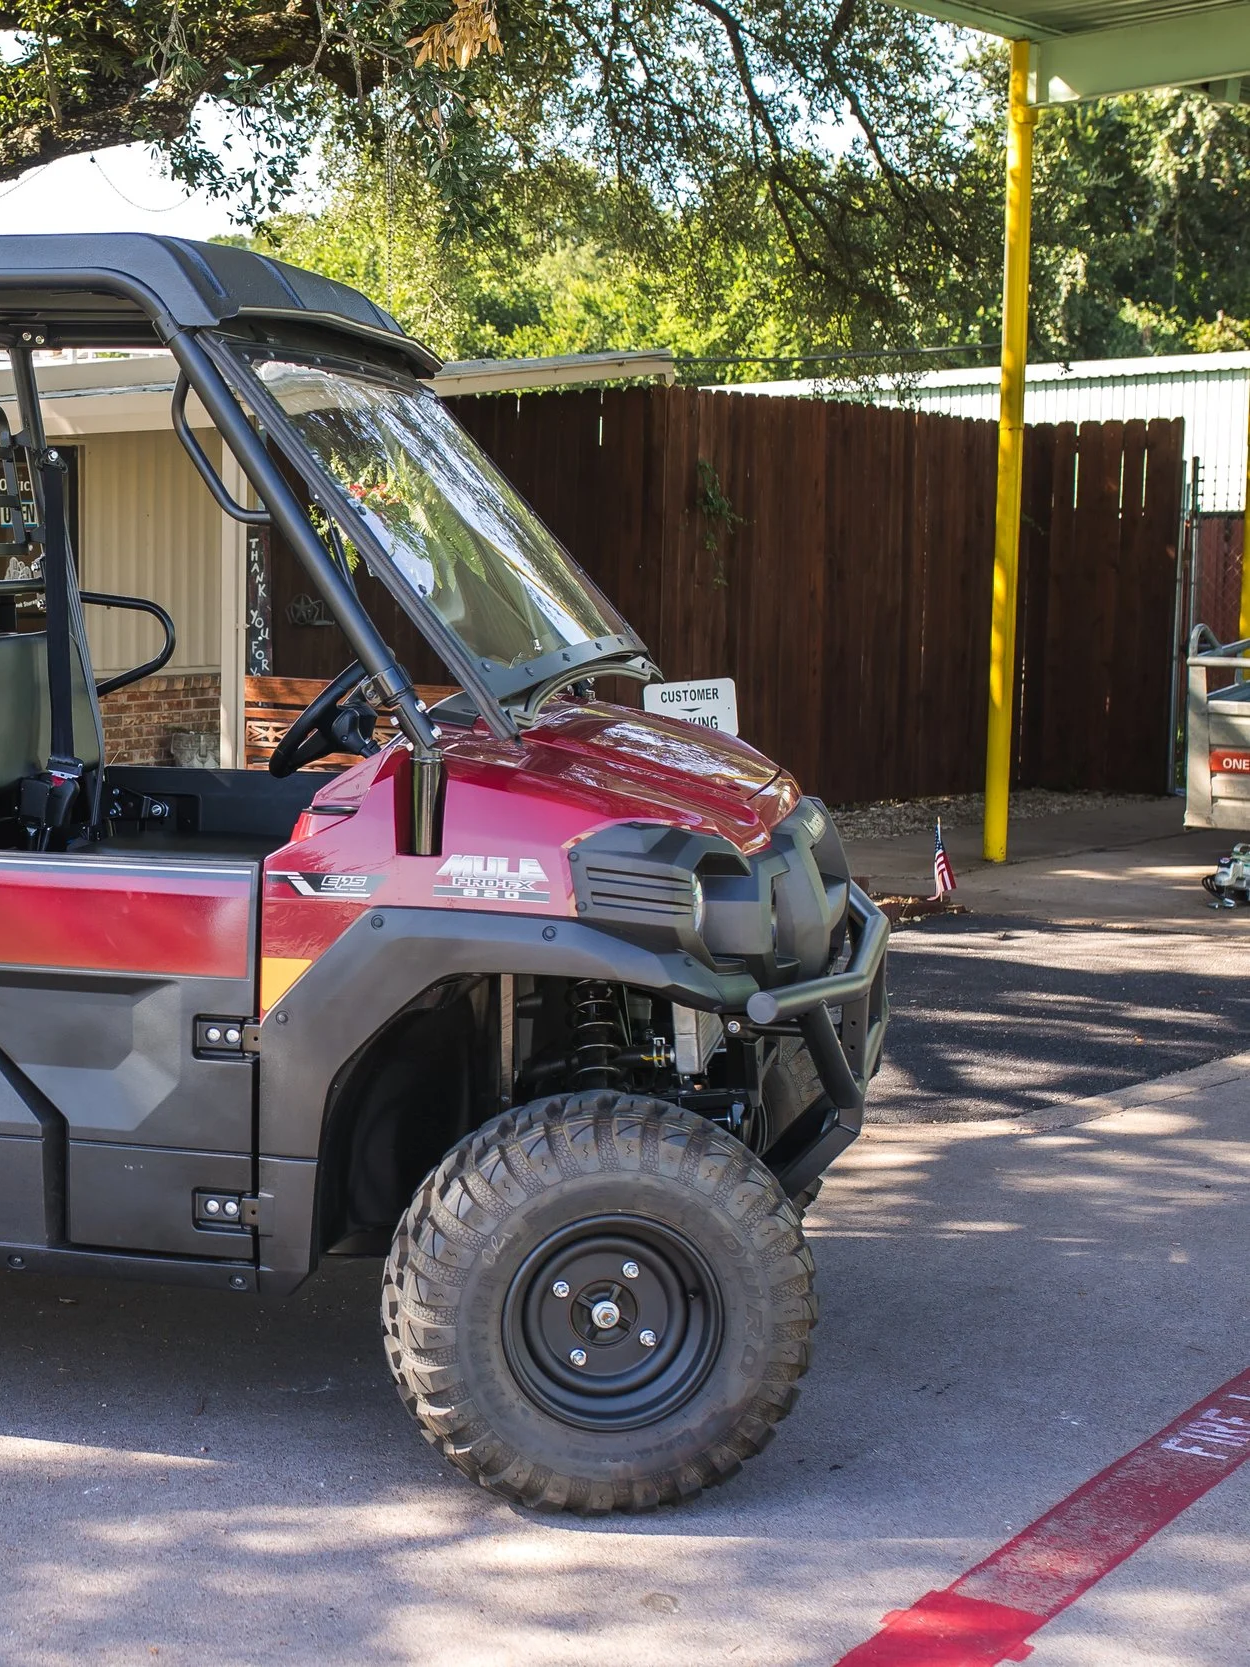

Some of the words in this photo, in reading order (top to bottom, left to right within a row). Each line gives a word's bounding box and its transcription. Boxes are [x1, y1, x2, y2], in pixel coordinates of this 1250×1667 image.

[249, 538, 267, 598] THANK
[250, 609, 269, 640] YOU
[251, 641, 270, 671] FOR
[660, 688, 719, 704] CUSTOMER
[1222, 757, 1250, 771] ONE
[321, 875, 368, 889] EPS
[435, 854, 549, 882] MULE
[462, 888, 520, 899] 820
[720, 1231, 765, 1380] DURO
[1160, 1408, 1250, 1460] FIRE
